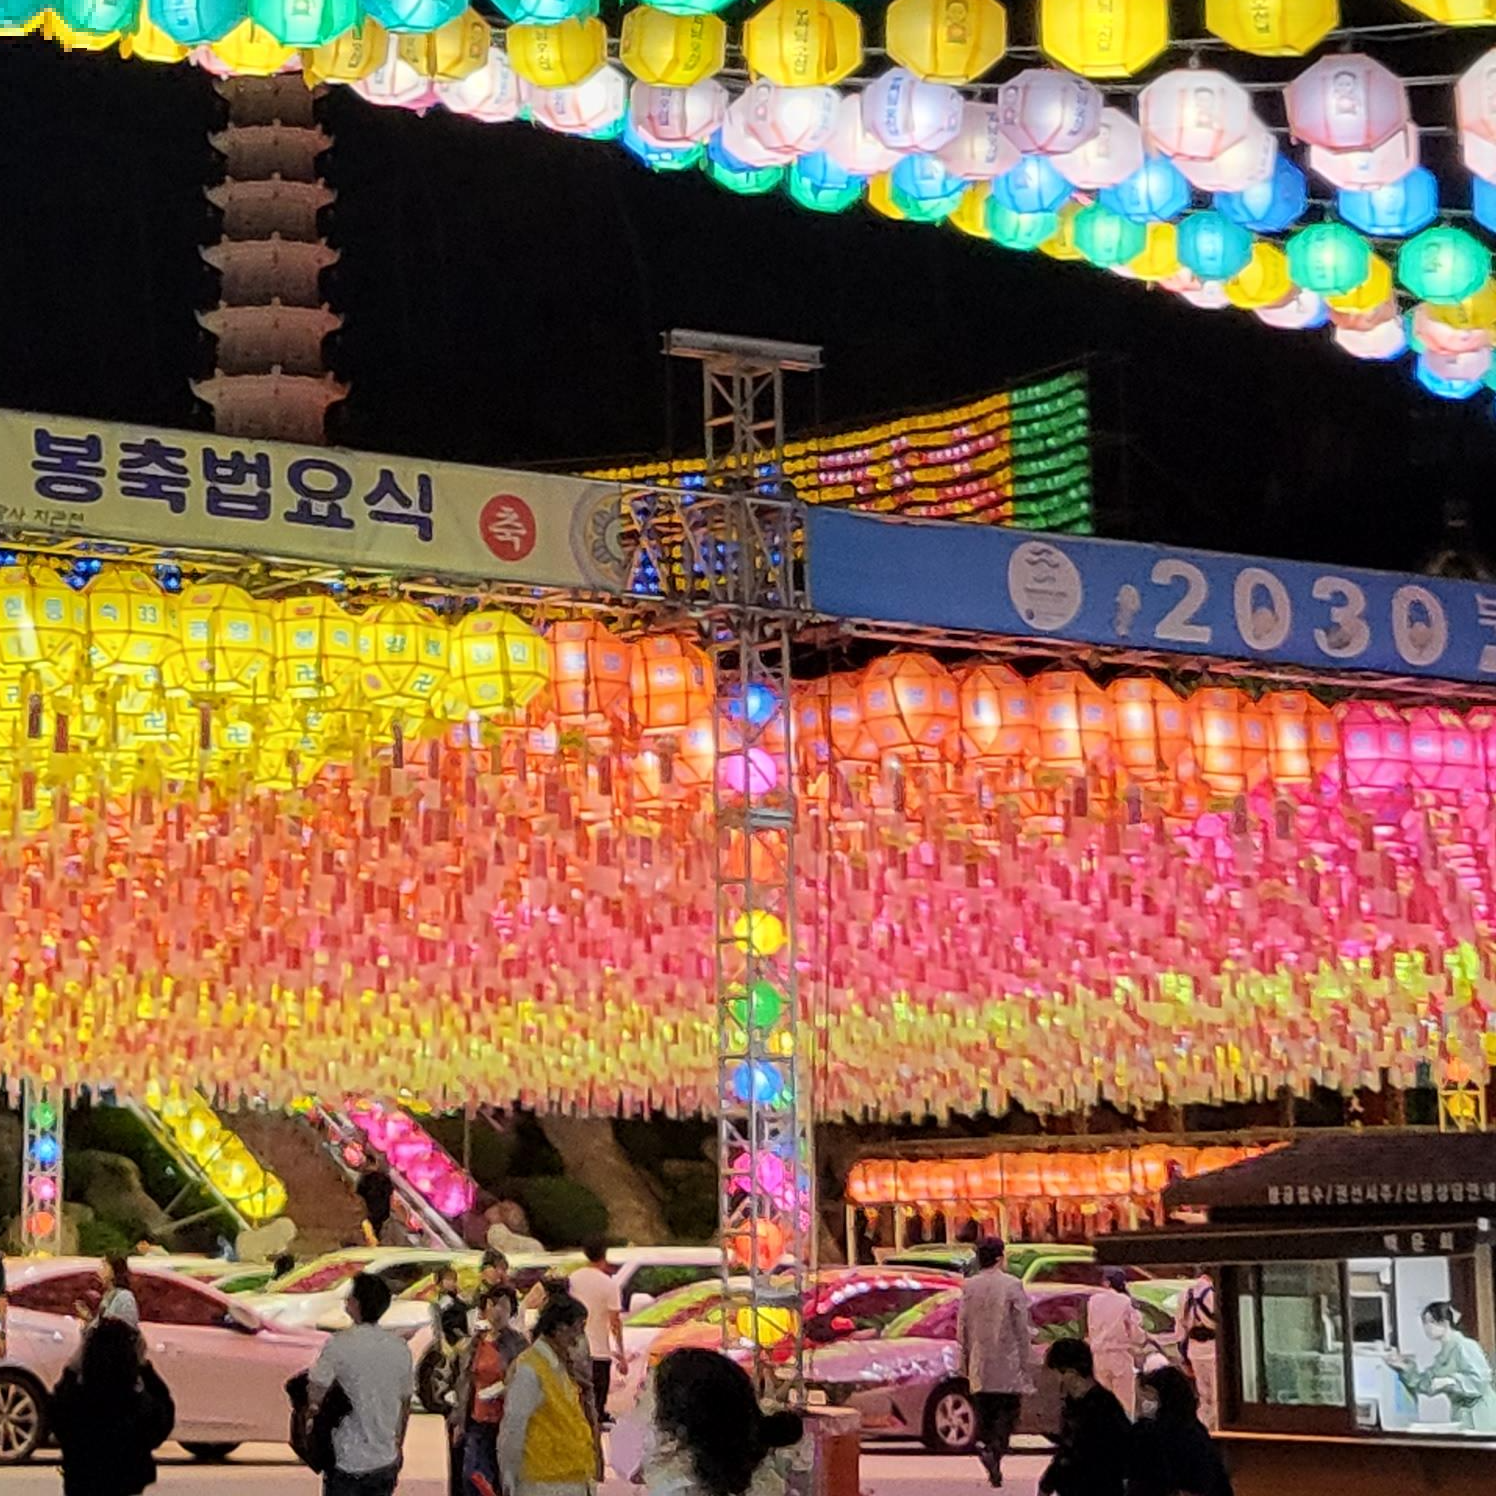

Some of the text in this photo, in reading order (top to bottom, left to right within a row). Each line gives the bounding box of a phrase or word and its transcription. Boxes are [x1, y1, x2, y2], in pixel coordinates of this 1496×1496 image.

[31, 427, 434, 543] 봉축법요식
[488, 505, 531, 554] 축
[1150, 557, 1448, 668] 2030
